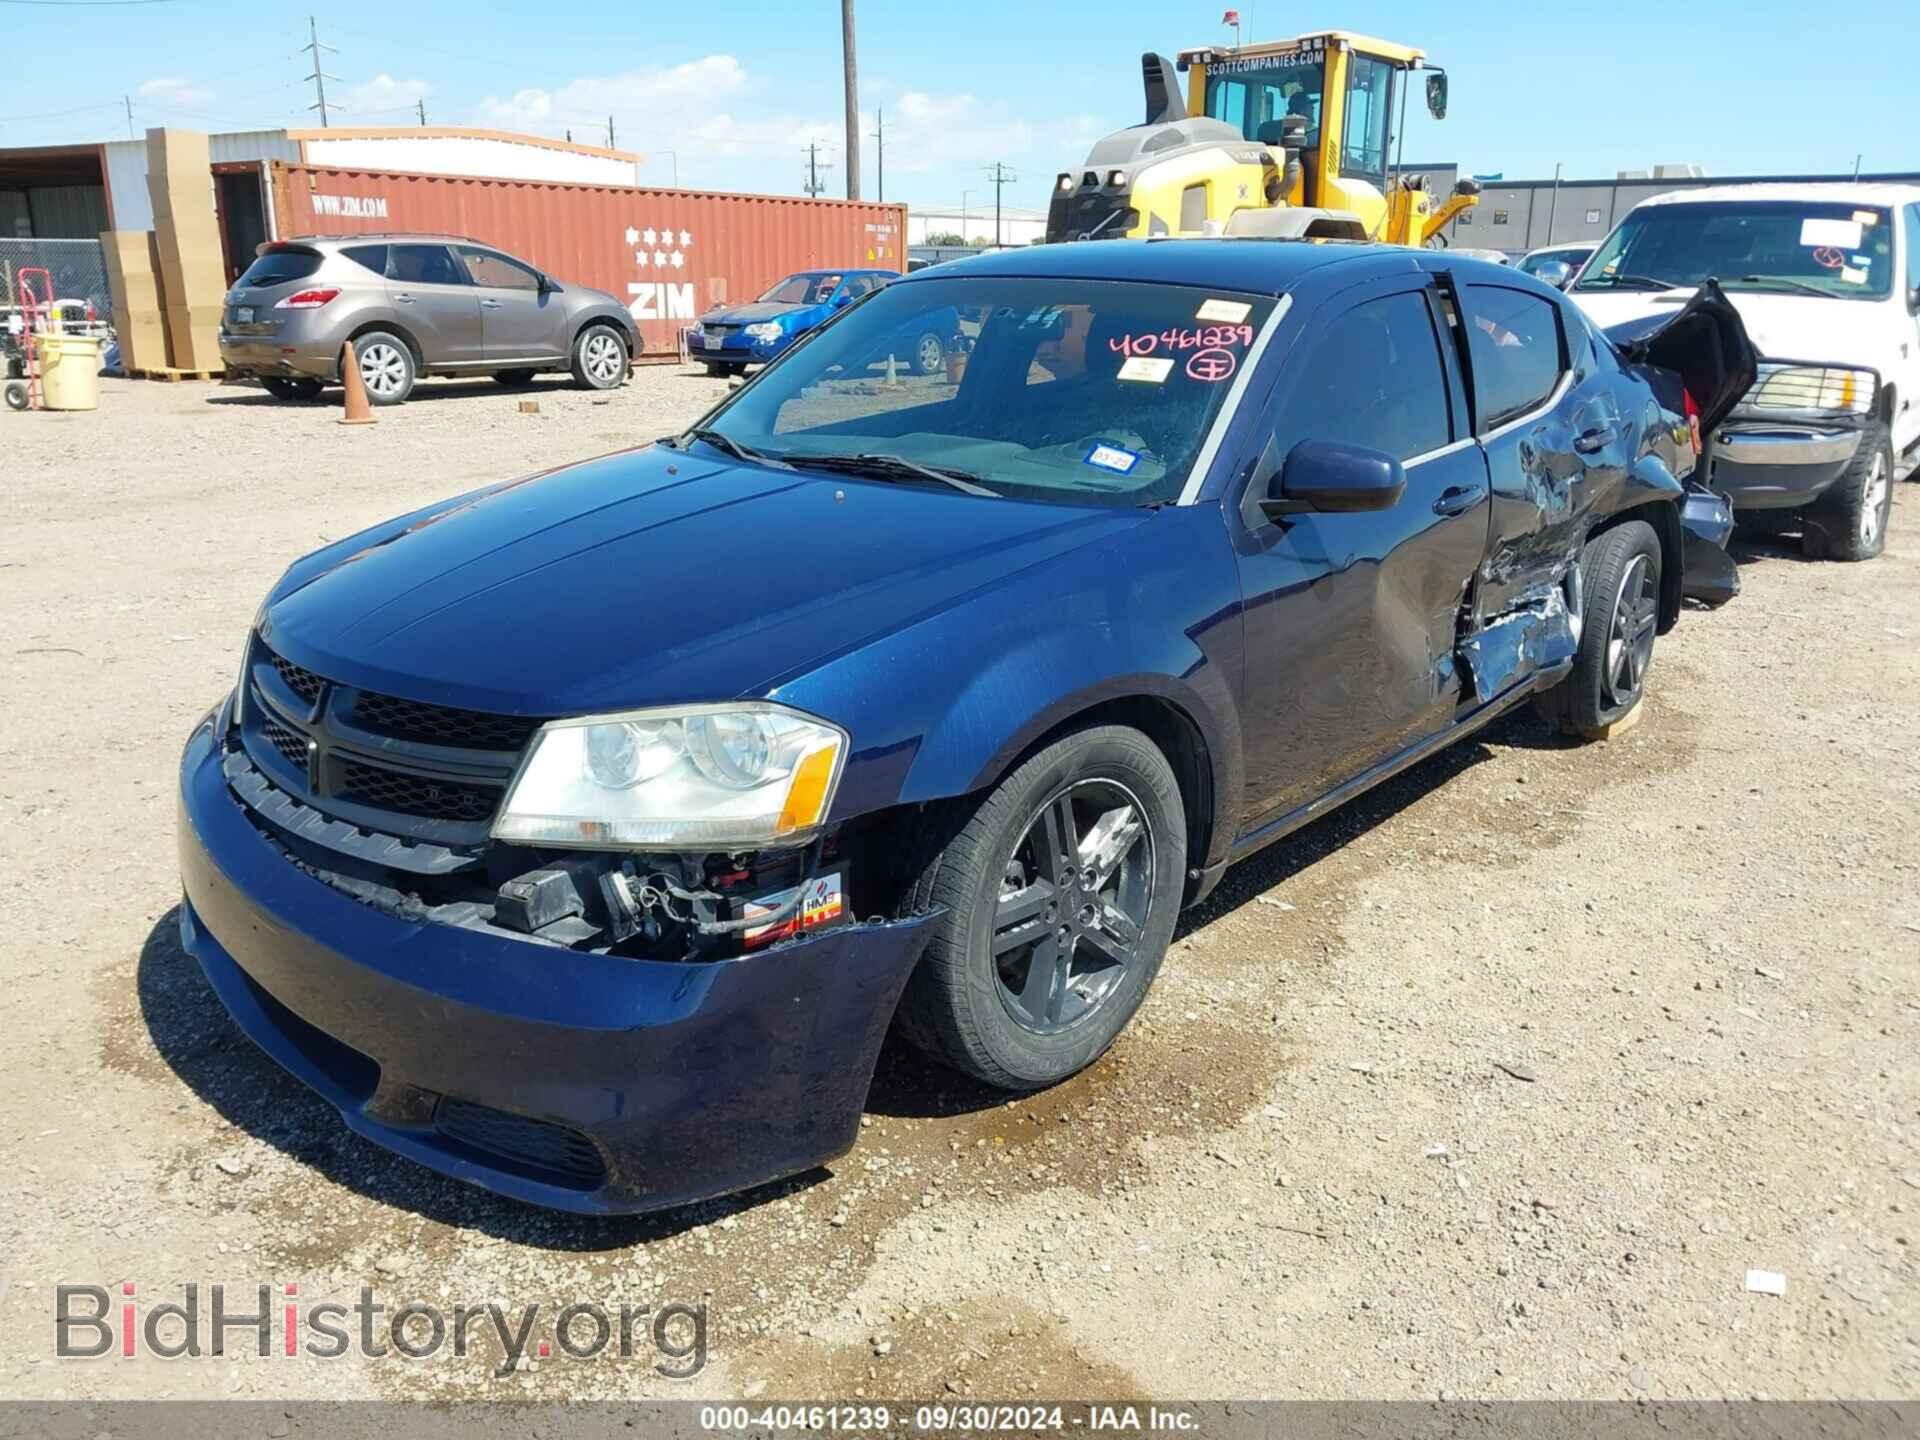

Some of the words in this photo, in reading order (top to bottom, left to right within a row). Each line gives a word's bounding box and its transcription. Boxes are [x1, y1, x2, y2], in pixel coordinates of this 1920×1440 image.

[1206, 50, 1325, 76] SCOTTCOMPANIES.COM
[311, 194, 389, 218] WWW.ZIM.COM
[627, 282, 695, 320] ZIM
[1109, 325, 1253, 358] 40461239
